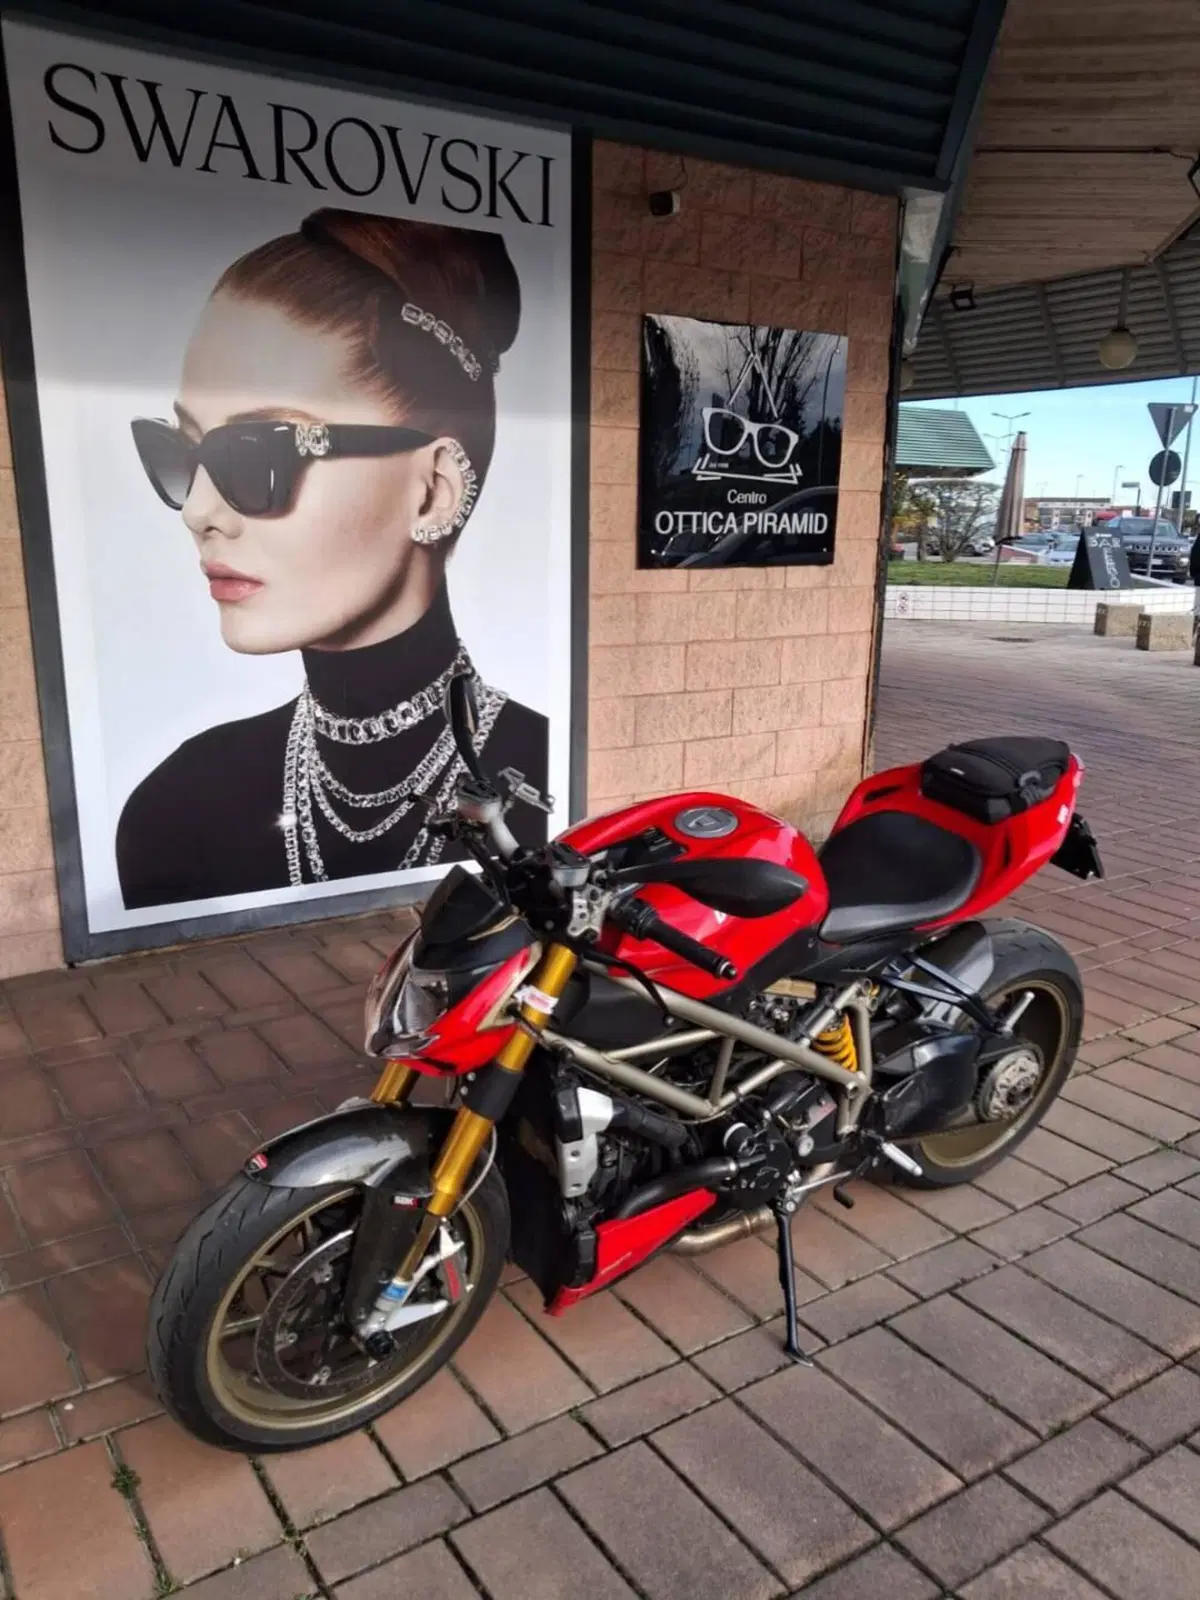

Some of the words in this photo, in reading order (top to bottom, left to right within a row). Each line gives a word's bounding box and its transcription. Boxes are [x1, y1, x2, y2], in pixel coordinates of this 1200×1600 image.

[43, 63, 556, 228] SWAROVSKI
[727, 489, 767, 504] Centro
[655, 510, 738, 535] OTTICA
[743, 512, 828, 535] PIRAMID
